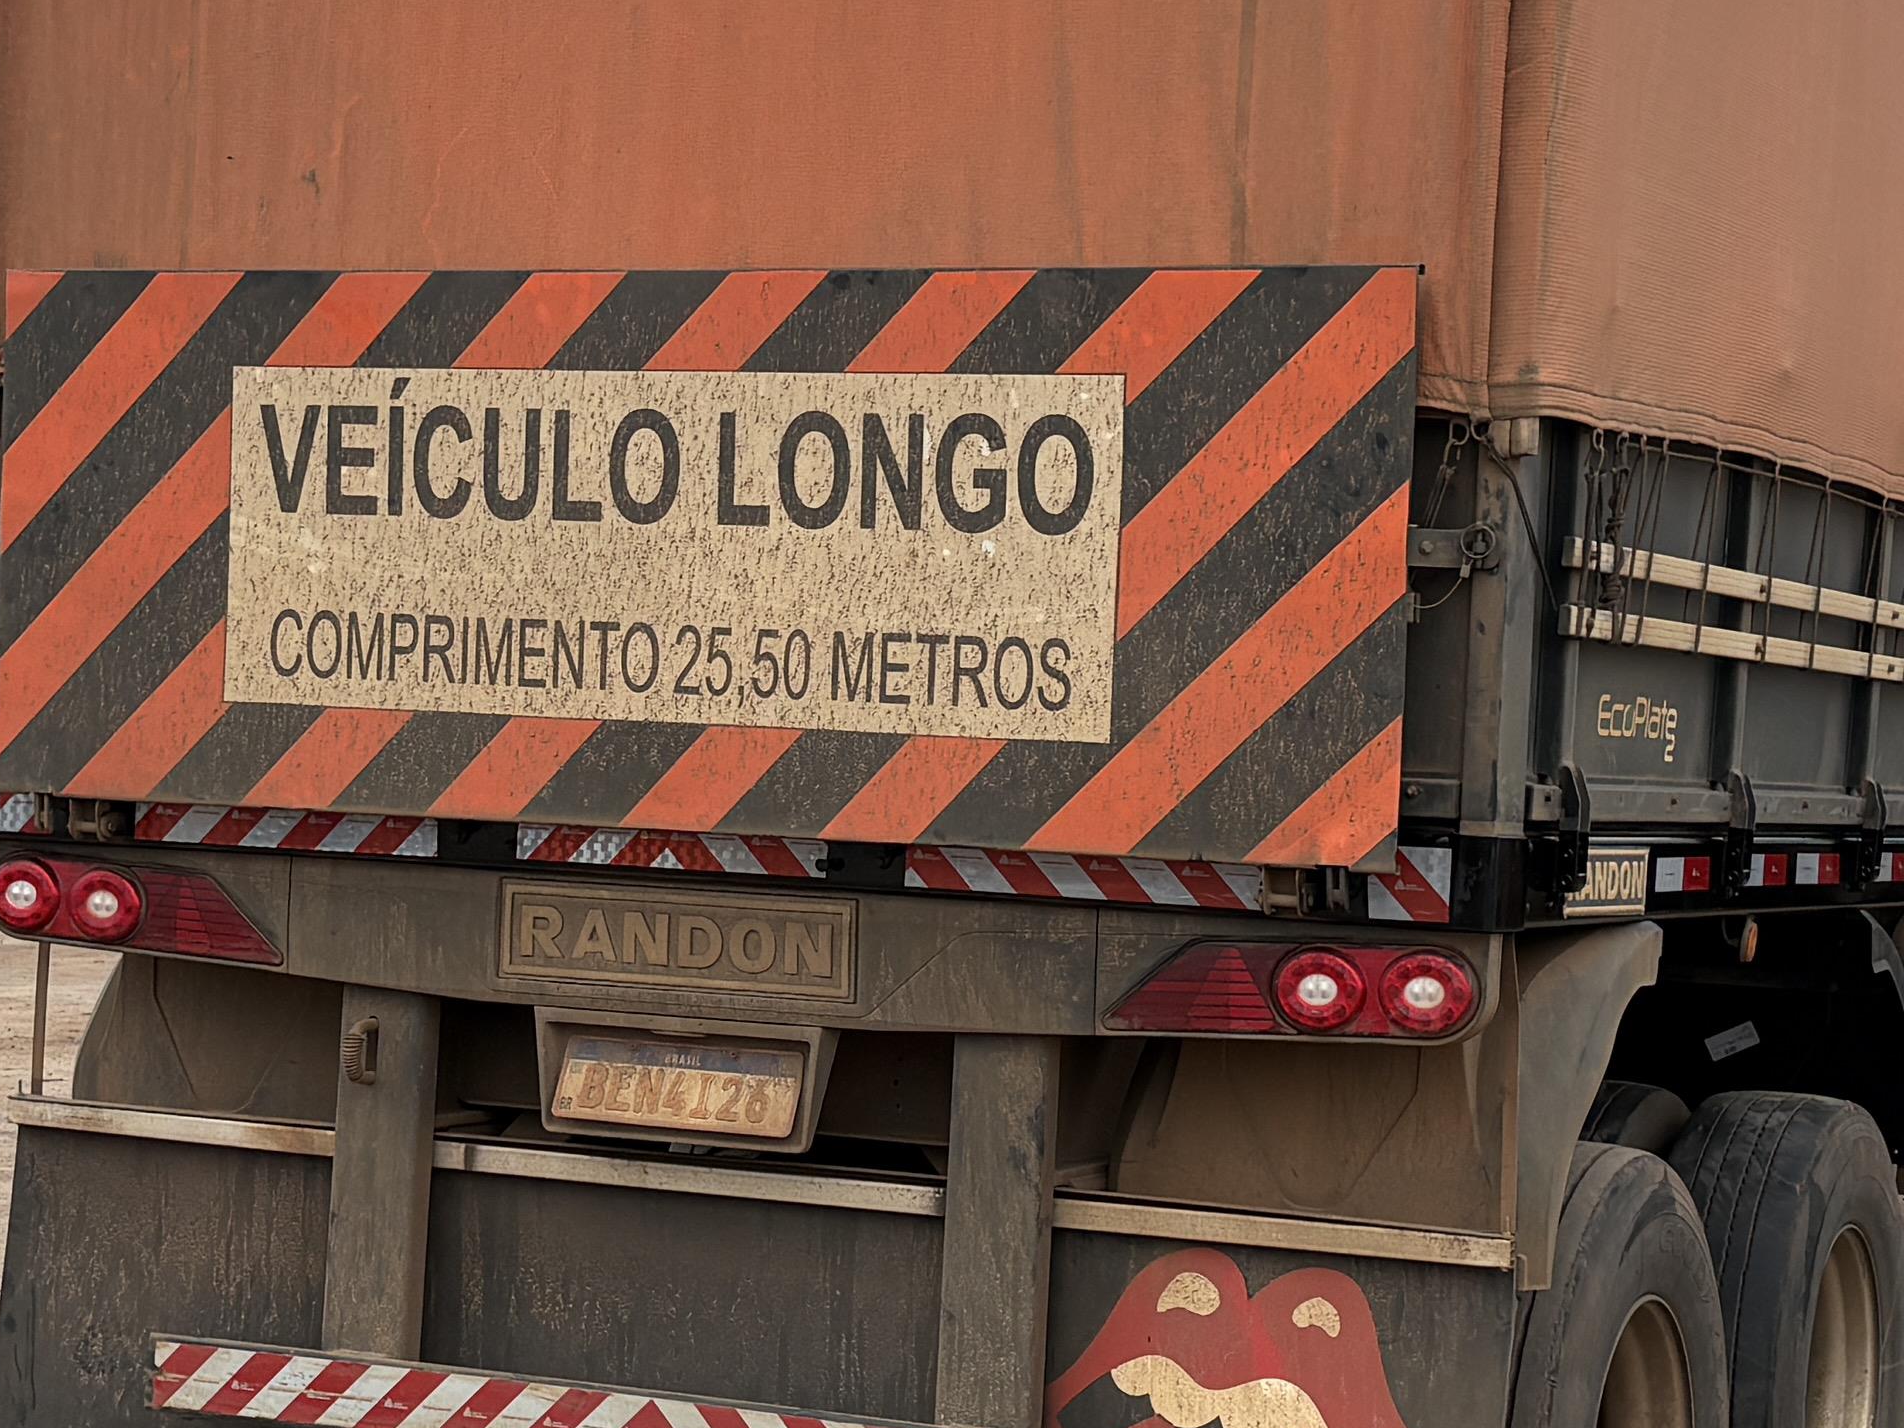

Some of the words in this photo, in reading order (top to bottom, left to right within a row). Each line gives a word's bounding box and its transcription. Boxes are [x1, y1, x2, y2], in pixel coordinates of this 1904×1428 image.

[260, 377, 680, 525] VEÍCULO
[717, 410, 1094, 536] LONGO
[269, 607, 662, 693] COMPRIMENTO
[674, 624, 810, 706] 25,50
[830, 632, 1072, 711] METROS
[1568, 861, 1644, 901] ANDON
[519, 903, 834, 979] RANDON
